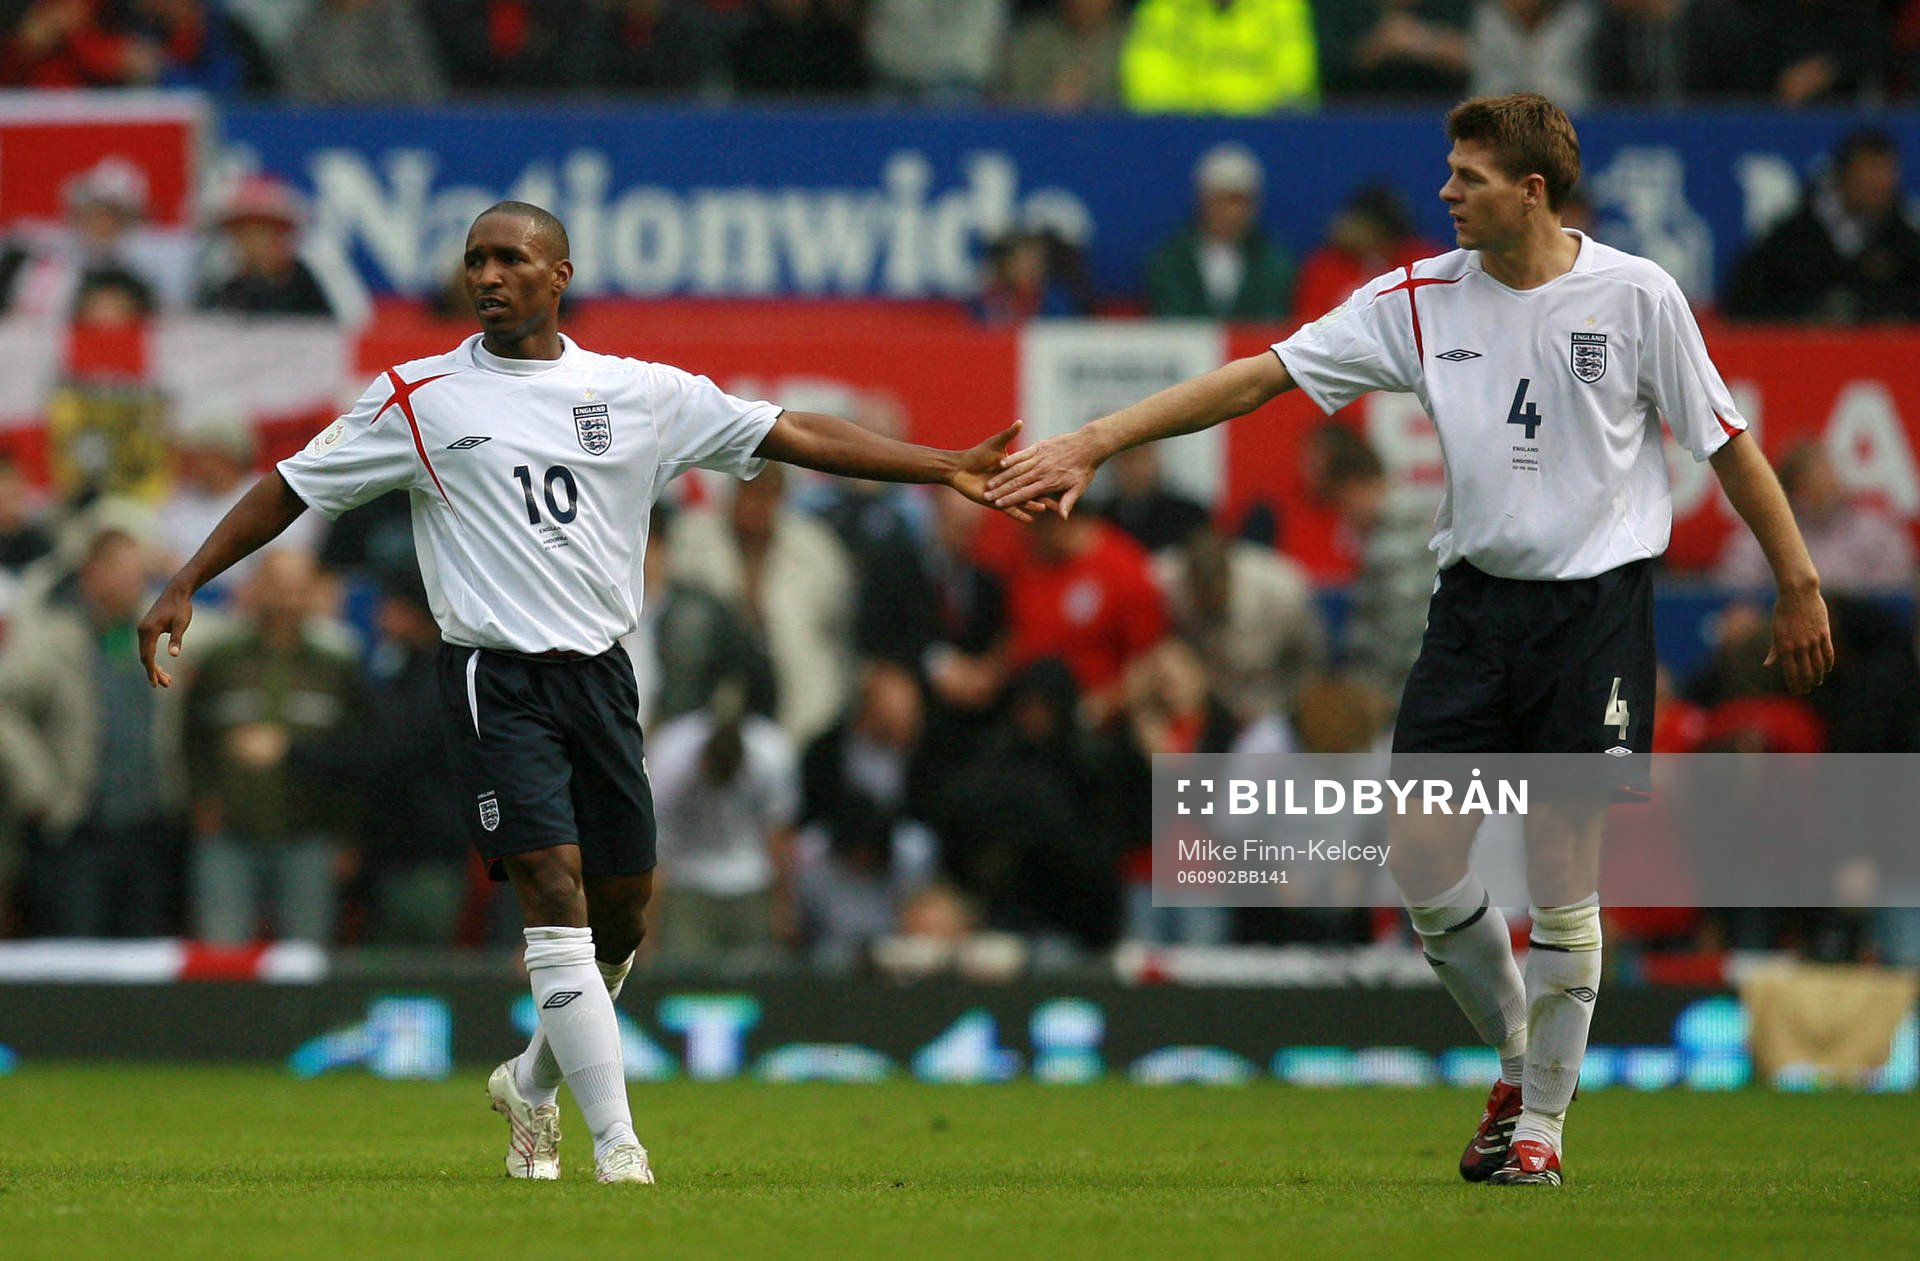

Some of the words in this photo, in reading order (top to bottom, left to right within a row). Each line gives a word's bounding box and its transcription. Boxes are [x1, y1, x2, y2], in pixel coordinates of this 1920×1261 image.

[1573, 334, 1606, 342] ENGLAND
[575, 406, 606, 415] ENGLAND
[1506, 378, 1542, 439] 4
[513, 465, 578, 525] 10
[1603, 677, 1630, 740] 4
